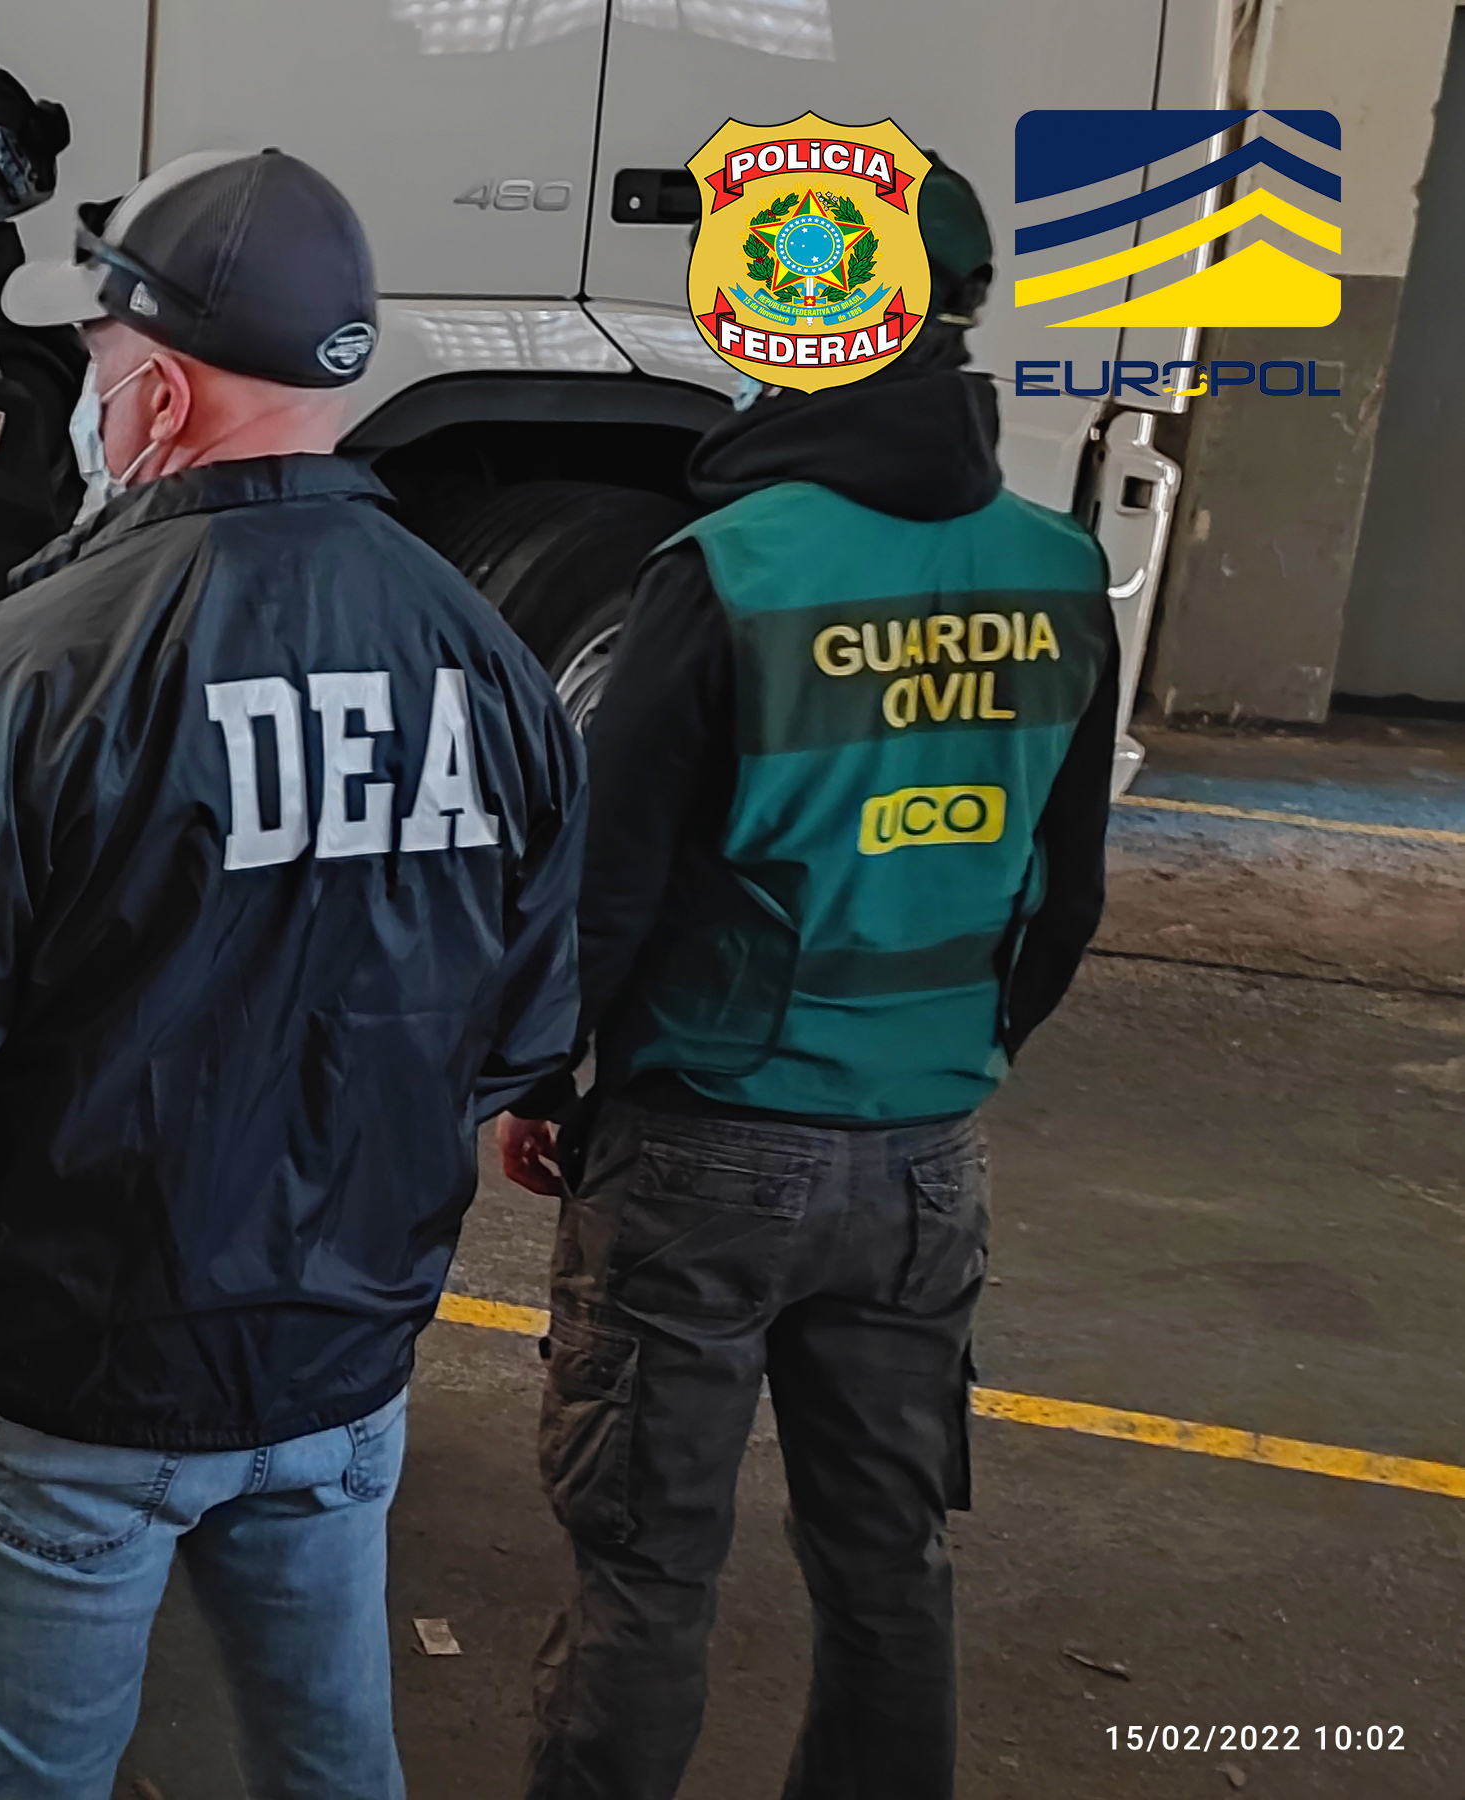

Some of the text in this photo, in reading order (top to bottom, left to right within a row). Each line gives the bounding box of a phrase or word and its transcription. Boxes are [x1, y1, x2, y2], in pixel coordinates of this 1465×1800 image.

[453, 179, 574, 212] 480
[812, 610, 1060, 677] GUARDIA
[882, 670, 1017, 729] CIVIL
[204, 667, 500, 871] DEA
[875, 792, 989, 844] UCO
